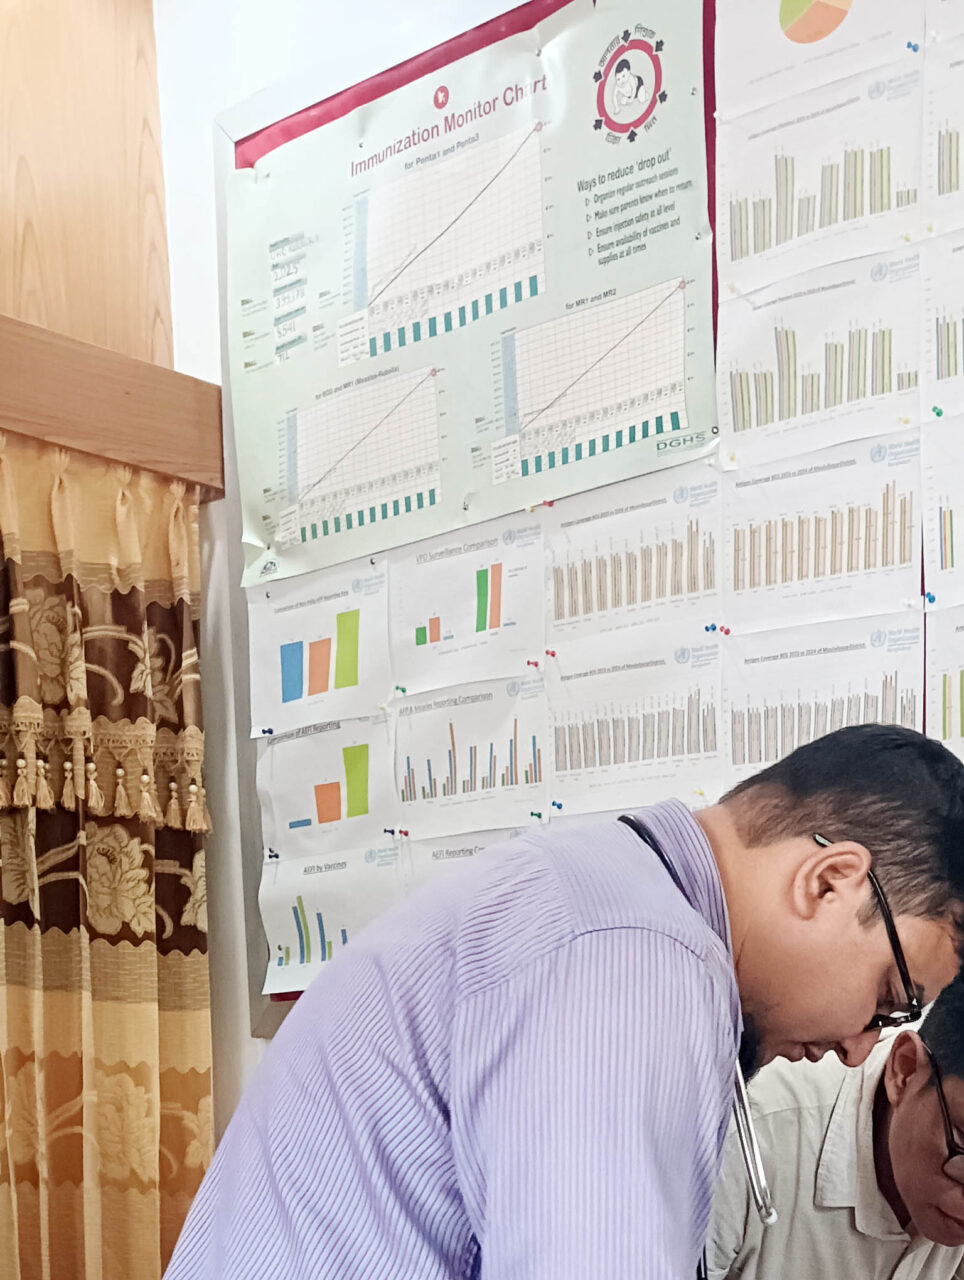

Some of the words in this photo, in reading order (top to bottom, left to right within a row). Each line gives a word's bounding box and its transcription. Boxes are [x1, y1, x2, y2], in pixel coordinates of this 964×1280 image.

[351, 127, 440, 176] Immunization
[443, 96, 498, 134] Monitor
[503, 75, 547, 106] Chrt
[404, 162, 414, 170] for
[415, 151, 440, 165] Penta1
[442, 146, 455, 157] and
[456, 133, 480, 148] Penta3
[577, 178, 597, 193] Ways
[598, 174, 606, 185] to
[607, 164, 634, 182] reduce
[594, 210, 608, 221] Make
[608, 206, 619, 216] sure
[620, 199, 639, 213] parents
[639, 194, 653, 204] know
[654, 188, 668, 198] when
[669, 186, 675, 194] to
[595, 226, 612, 238] Ensure
[613, 218, 634, 233] injection
[635, 211, 649, 224] safety
[650, 209, 655, 217] at
[663, 200, 676, 213] level
[597, 241, 614, 253] Ensure
[615, 231, 641, 247] availability
[642, 227, 648, 238] of
[648, 222, 669, 235] vaccines
[670, 216, 681, 227] and
[619, 250, 625, 259] at
[632, 243, 647, 252] times
[565, 302, 574, 310] for
[575, 298, 589, 307] MR1
[590, 295, 602, 303] and
[602, 288, 617, 299] MR2
[656, 432, 707, 450] DGHS
[463, 538, 499, 553] Comparison
[458, 692, 494, 704] Comparison
[445, 847, 474, 857] Reporting
